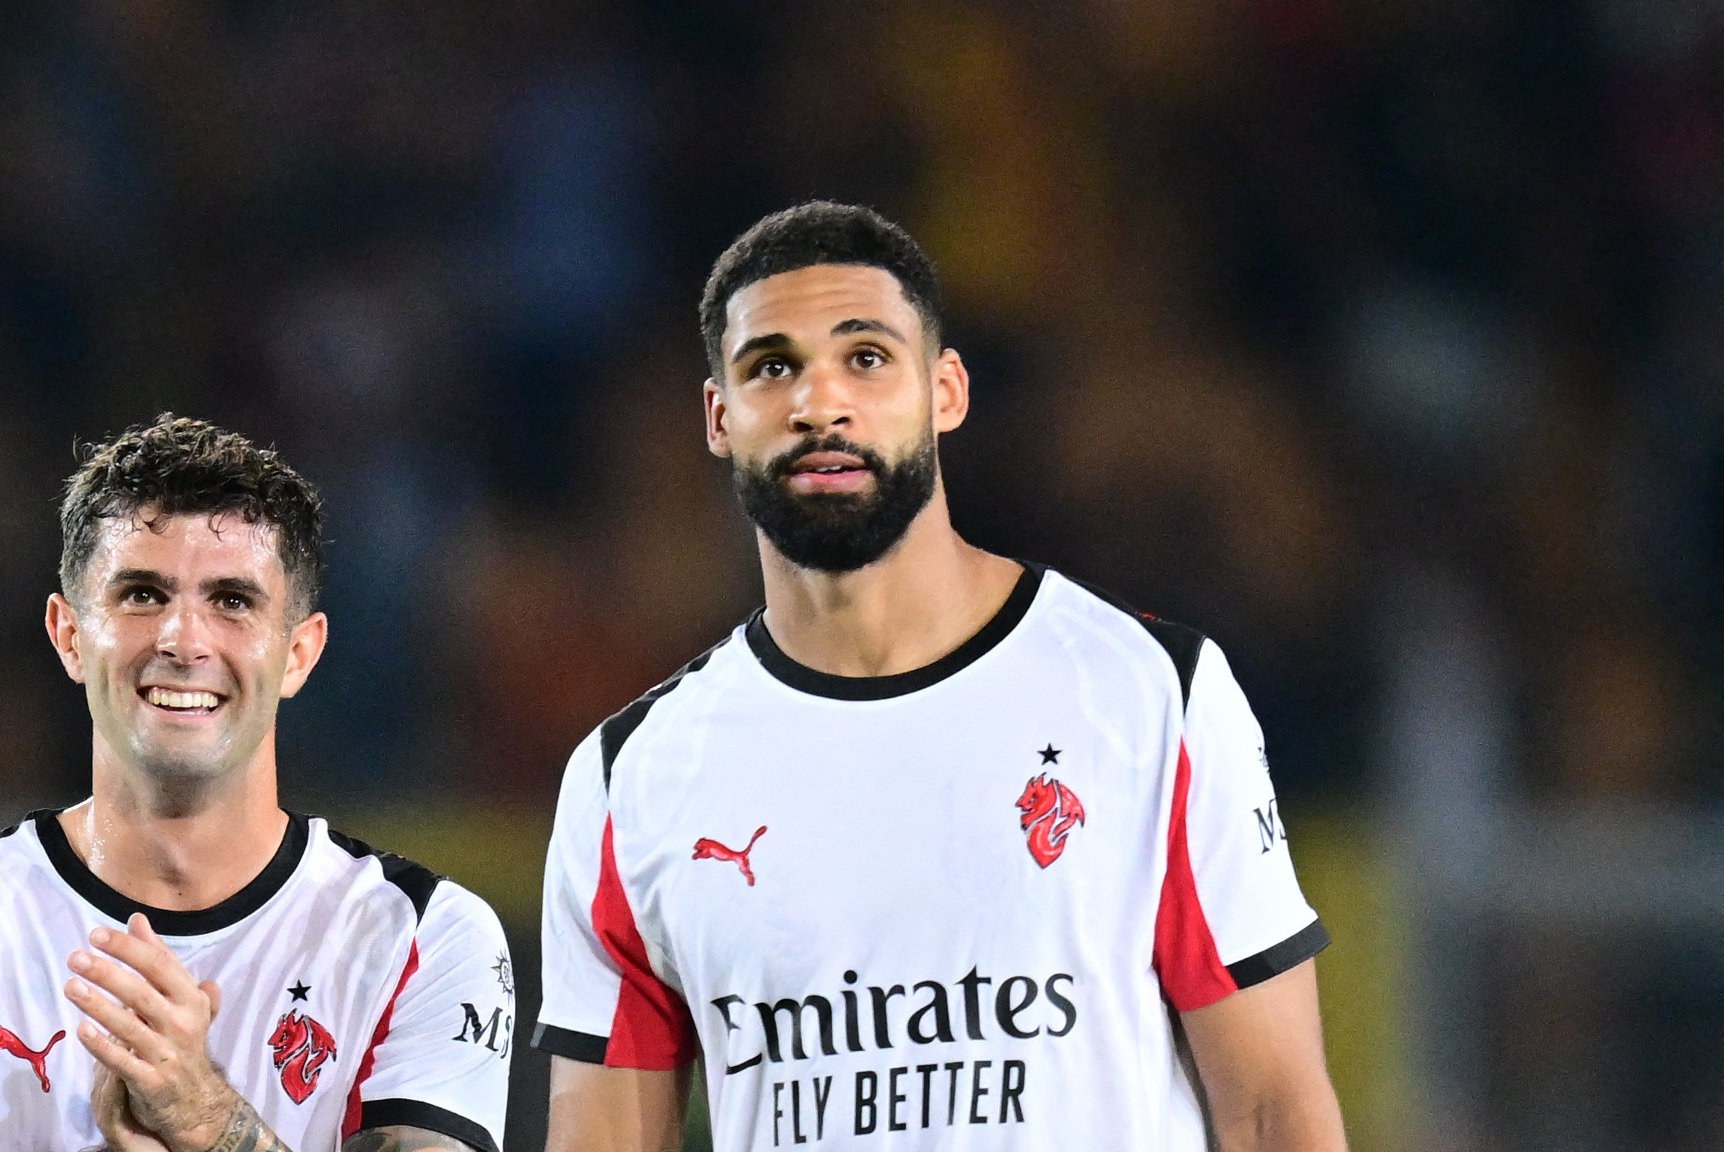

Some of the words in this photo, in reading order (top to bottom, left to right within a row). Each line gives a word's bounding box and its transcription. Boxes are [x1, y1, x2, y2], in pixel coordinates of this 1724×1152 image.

[711, 964, 1077, 1075] Emirates
[773, 1075, 832, 1147] FLY
[854, 1060, 1026, 1136] BETTER
